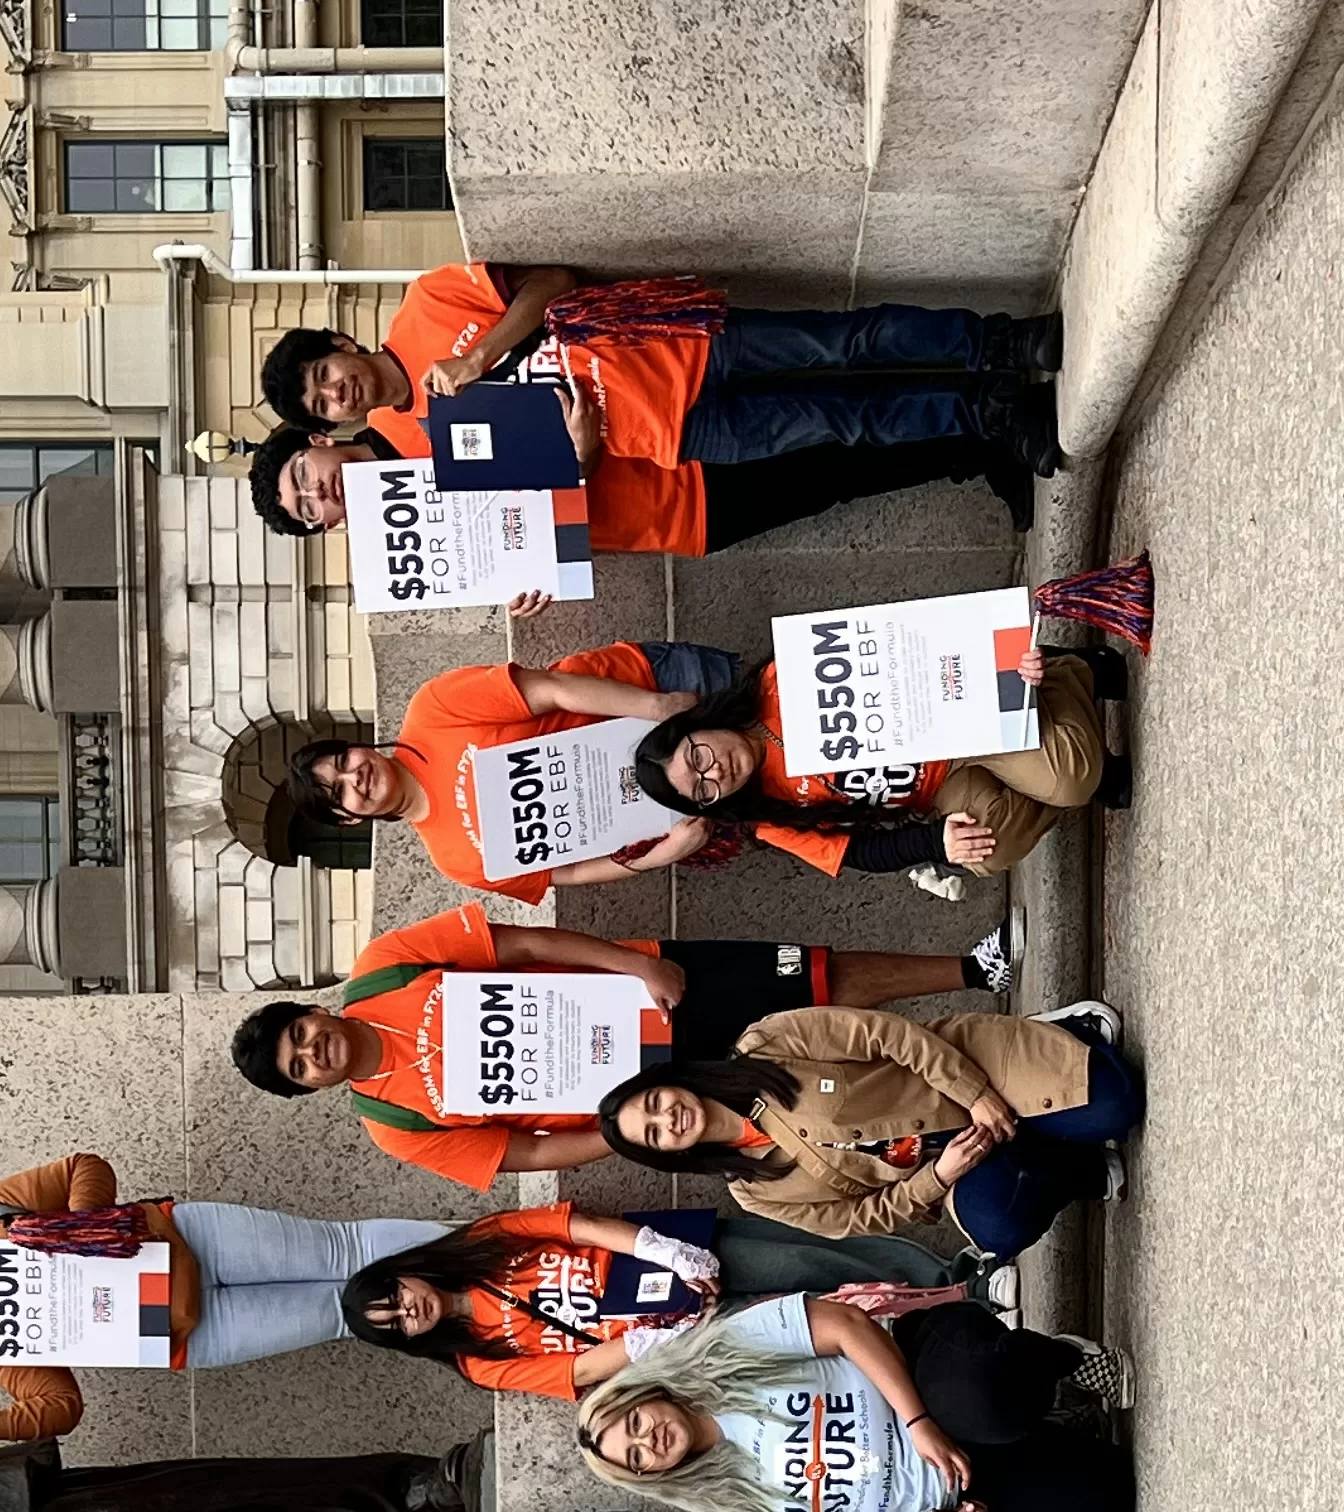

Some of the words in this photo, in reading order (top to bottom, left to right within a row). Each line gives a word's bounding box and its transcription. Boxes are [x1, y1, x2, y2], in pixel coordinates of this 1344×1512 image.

[451, 321, 480, 358] FY26
[422, 470, 446, 524] EBF
[379, 470, 430, 600] $550M
[512, 506, 524, 550] FUTURE
[429, 537, 451, 594] FOR
[856, 620, 880, 677] EBF
[810, 620, 864, 762] $550M
[884, 621, 904, 746] #FundtheFormula
[951, 654, 964, 700] FUTURE
[863, 692, 886, 752] FOR
[455, 774, 467, 784] in
[547, 744, 568, 792] EBF
[796, 776, 809, 794] for
[454, 785, 468, 810] EBF
[507, 746, 553, 865] $550M
[572, 743, 589, 846] #FundtheFormula
[552, 802, 573, 855] FOR
[422, 1015, 432, 1028] in
[423, 982, 444, 1014] FY26
[521, 985, 538, 1035] EBF
[416, 1028, 428, 1054] EBF
[478, 984, 518, 1105] $550M
[544, 990, 554, 1098] #FundtheFormula
[601, 1024, 611, 1065] FUTURE
[521, 1048, 538, 1102] FOR
[26, 1249, 42, 1294] EBF
[537, 1252, 563, 1354] UNDING
[26, 1307, 42, 1354] FOR
[858, 1389, 869, 1430] Schools
[860, 1432, 870, 1462] Better
[878, 1422, 894, 1512] #FundtheFormula
